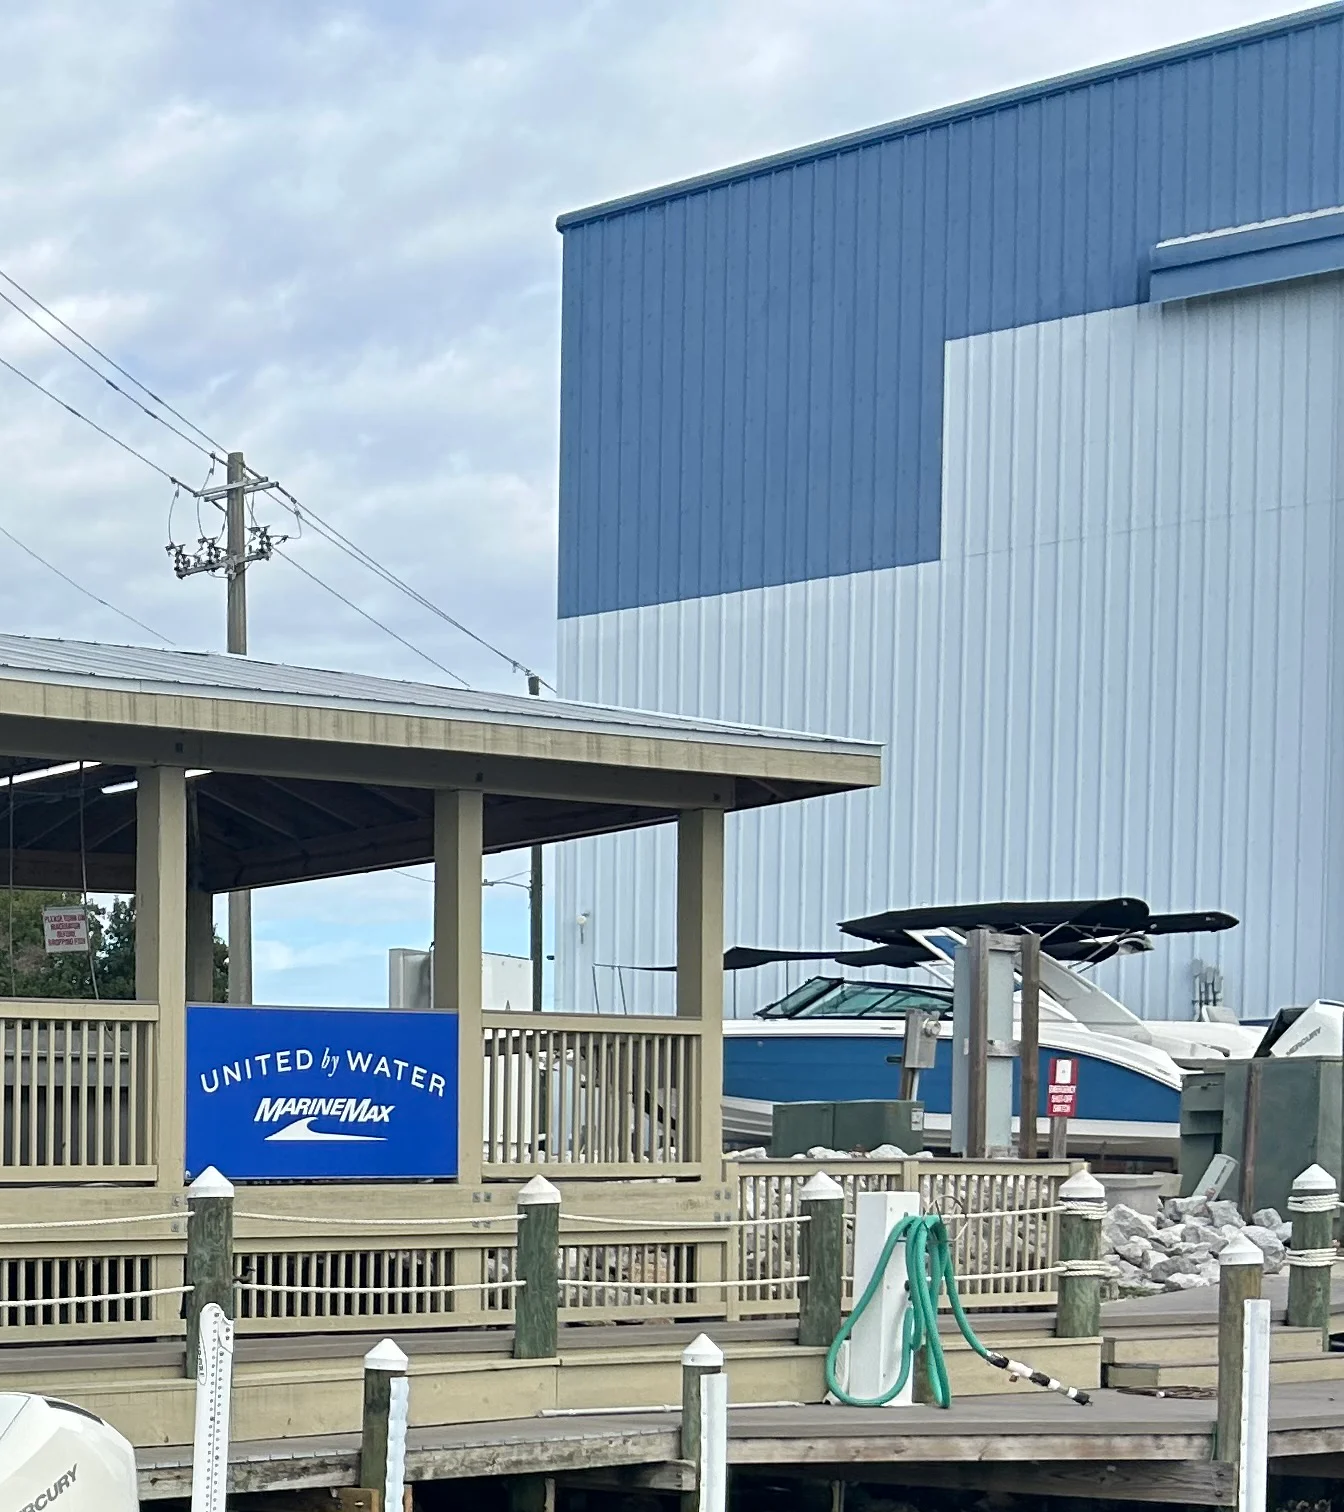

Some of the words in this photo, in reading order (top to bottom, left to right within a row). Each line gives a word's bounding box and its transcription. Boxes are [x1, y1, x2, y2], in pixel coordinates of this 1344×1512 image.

[200, 1048, 313, 1093] UNITED
[321, 1047, 340, 1077] by
[346, 1049, 446, 1097] WATER
